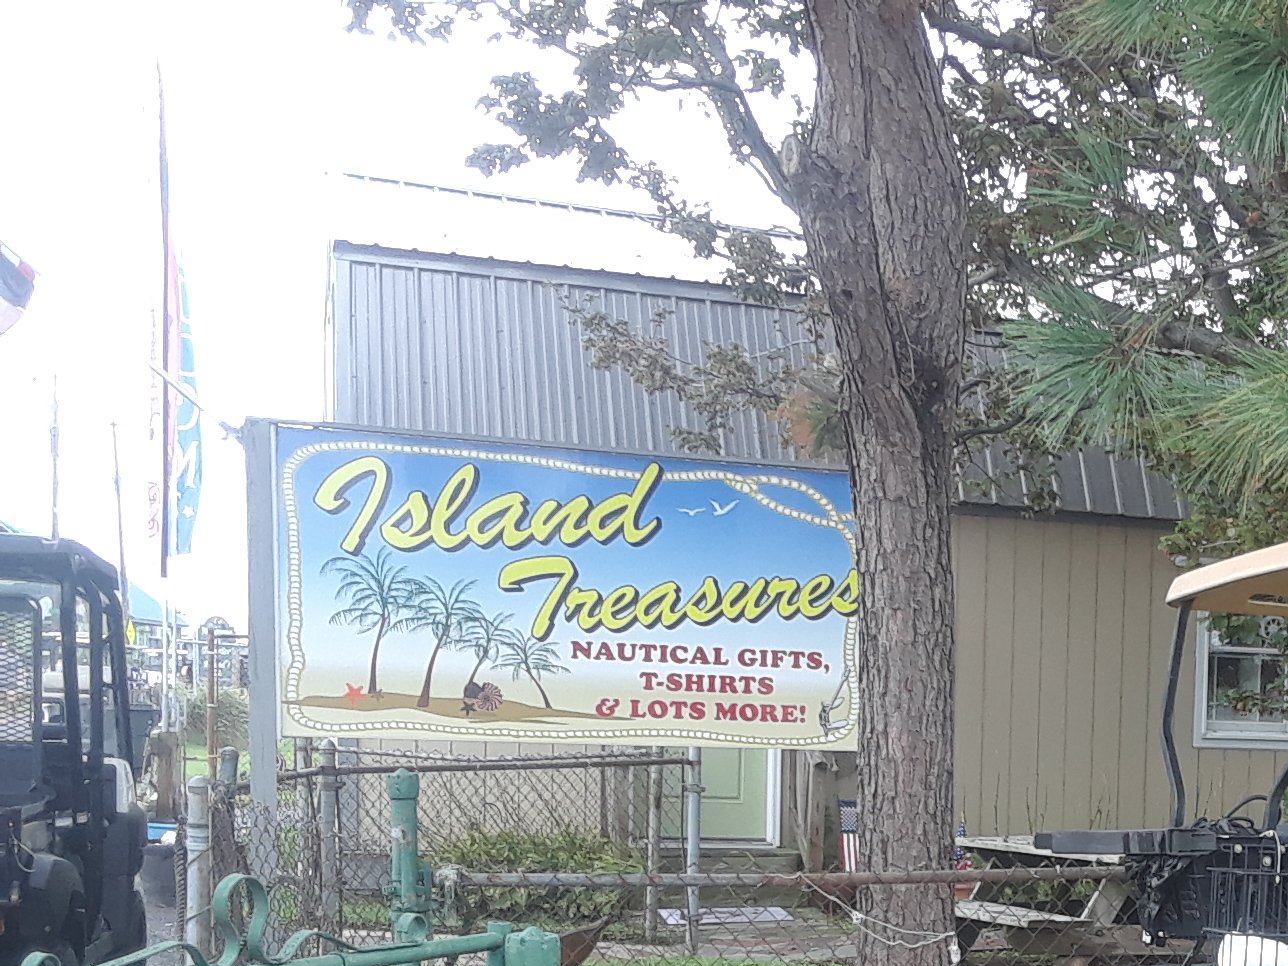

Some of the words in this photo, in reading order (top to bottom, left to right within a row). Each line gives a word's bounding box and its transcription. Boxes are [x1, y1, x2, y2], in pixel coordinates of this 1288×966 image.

[313, 455, 663, 556] Island
[499, 554, 860, 641] Treasures
[570, 640, 729, 667] NAUTICAL
[737, 649, 831, 674] GIFTS,
[639, 671, 774, 695] T-SHIRTS
[595, 698, 620, 719] &
[630, 700, 707, 721] LOTS
[714, 703, 807, 724] MORE!
